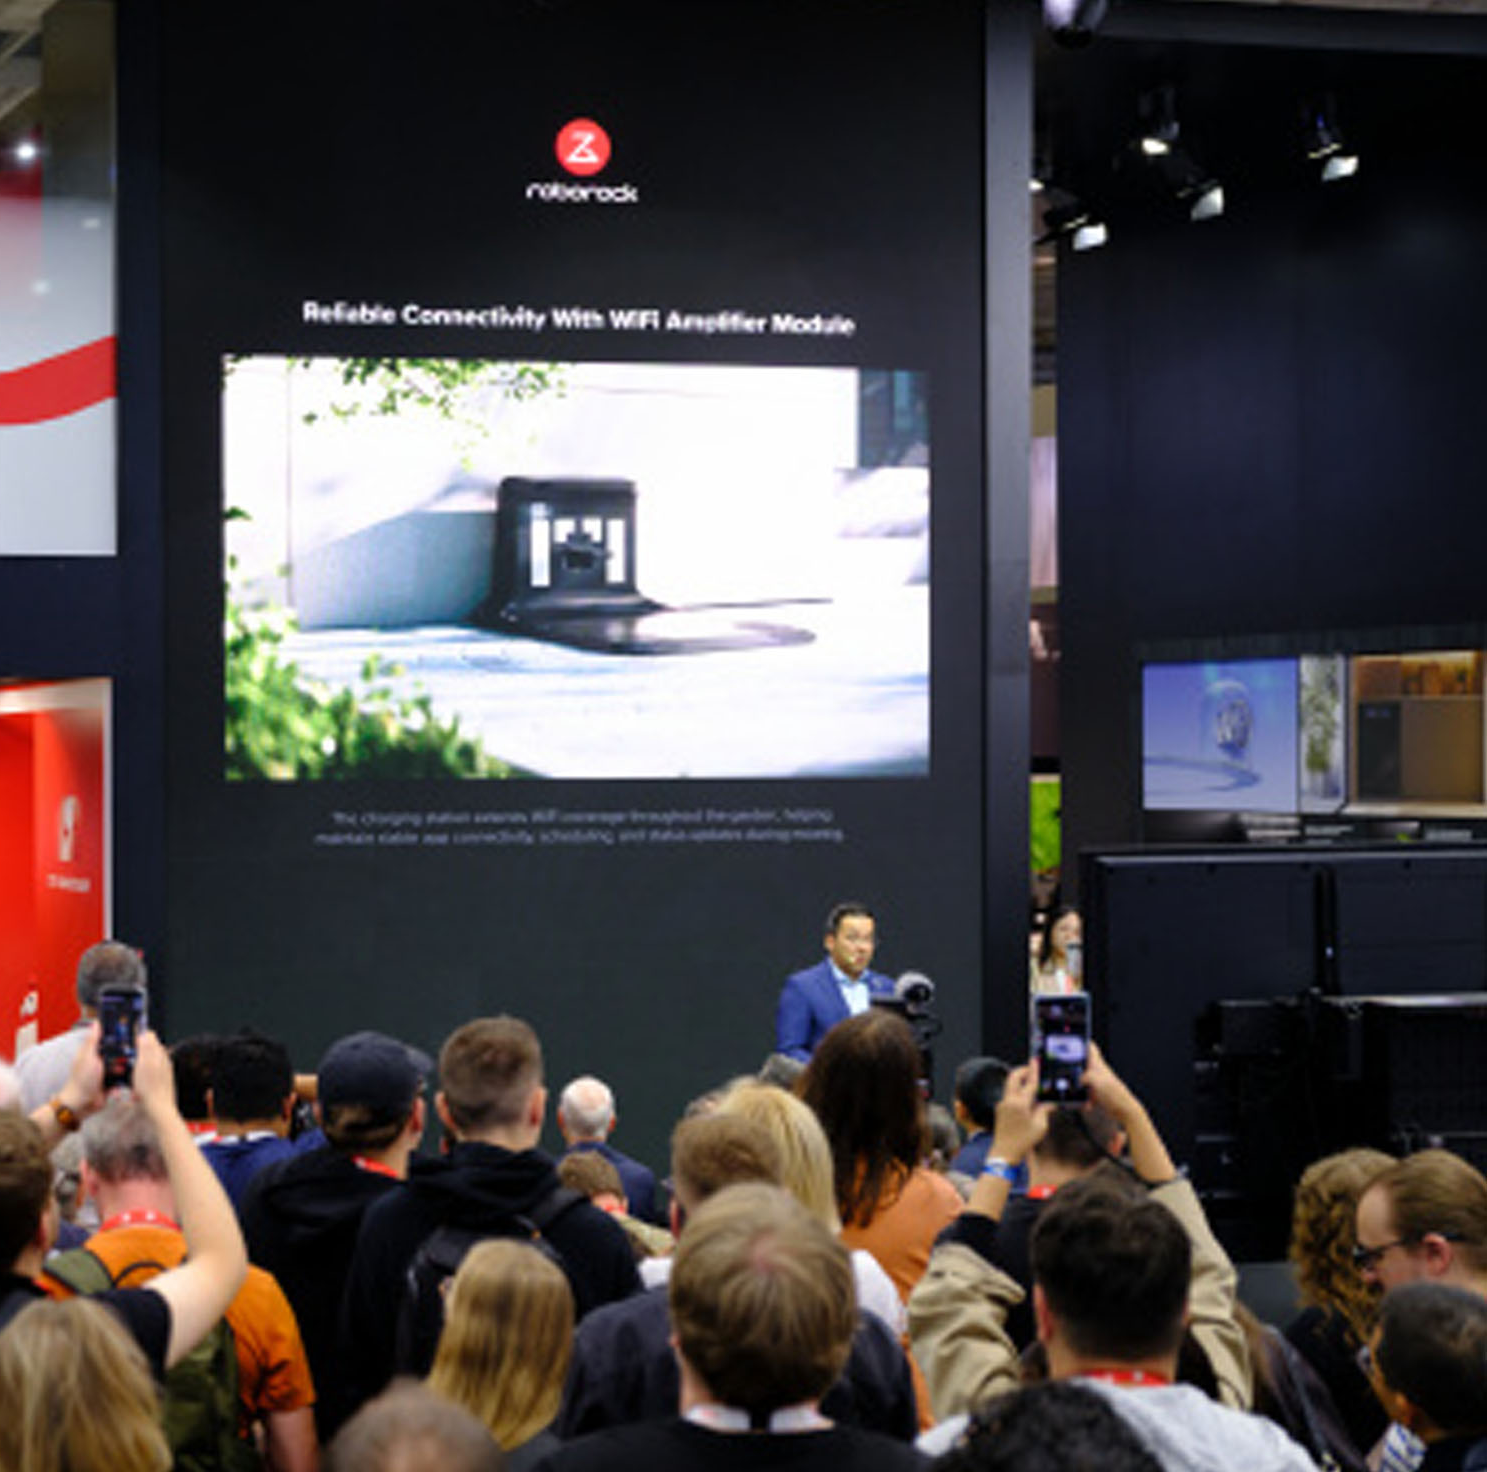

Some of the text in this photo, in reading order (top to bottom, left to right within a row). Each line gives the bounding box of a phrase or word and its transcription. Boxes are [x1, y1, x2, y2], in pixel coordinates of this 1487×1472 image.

[525, 181, 639, 203] roborock
[302, 302, 396, 324] Reliable
[401, 304, 547, 331] Connectivity
[549, 306, 605, 330] With
[666, 311, 767, 335] Amplifier
[770, 313, 857, 337] Module
